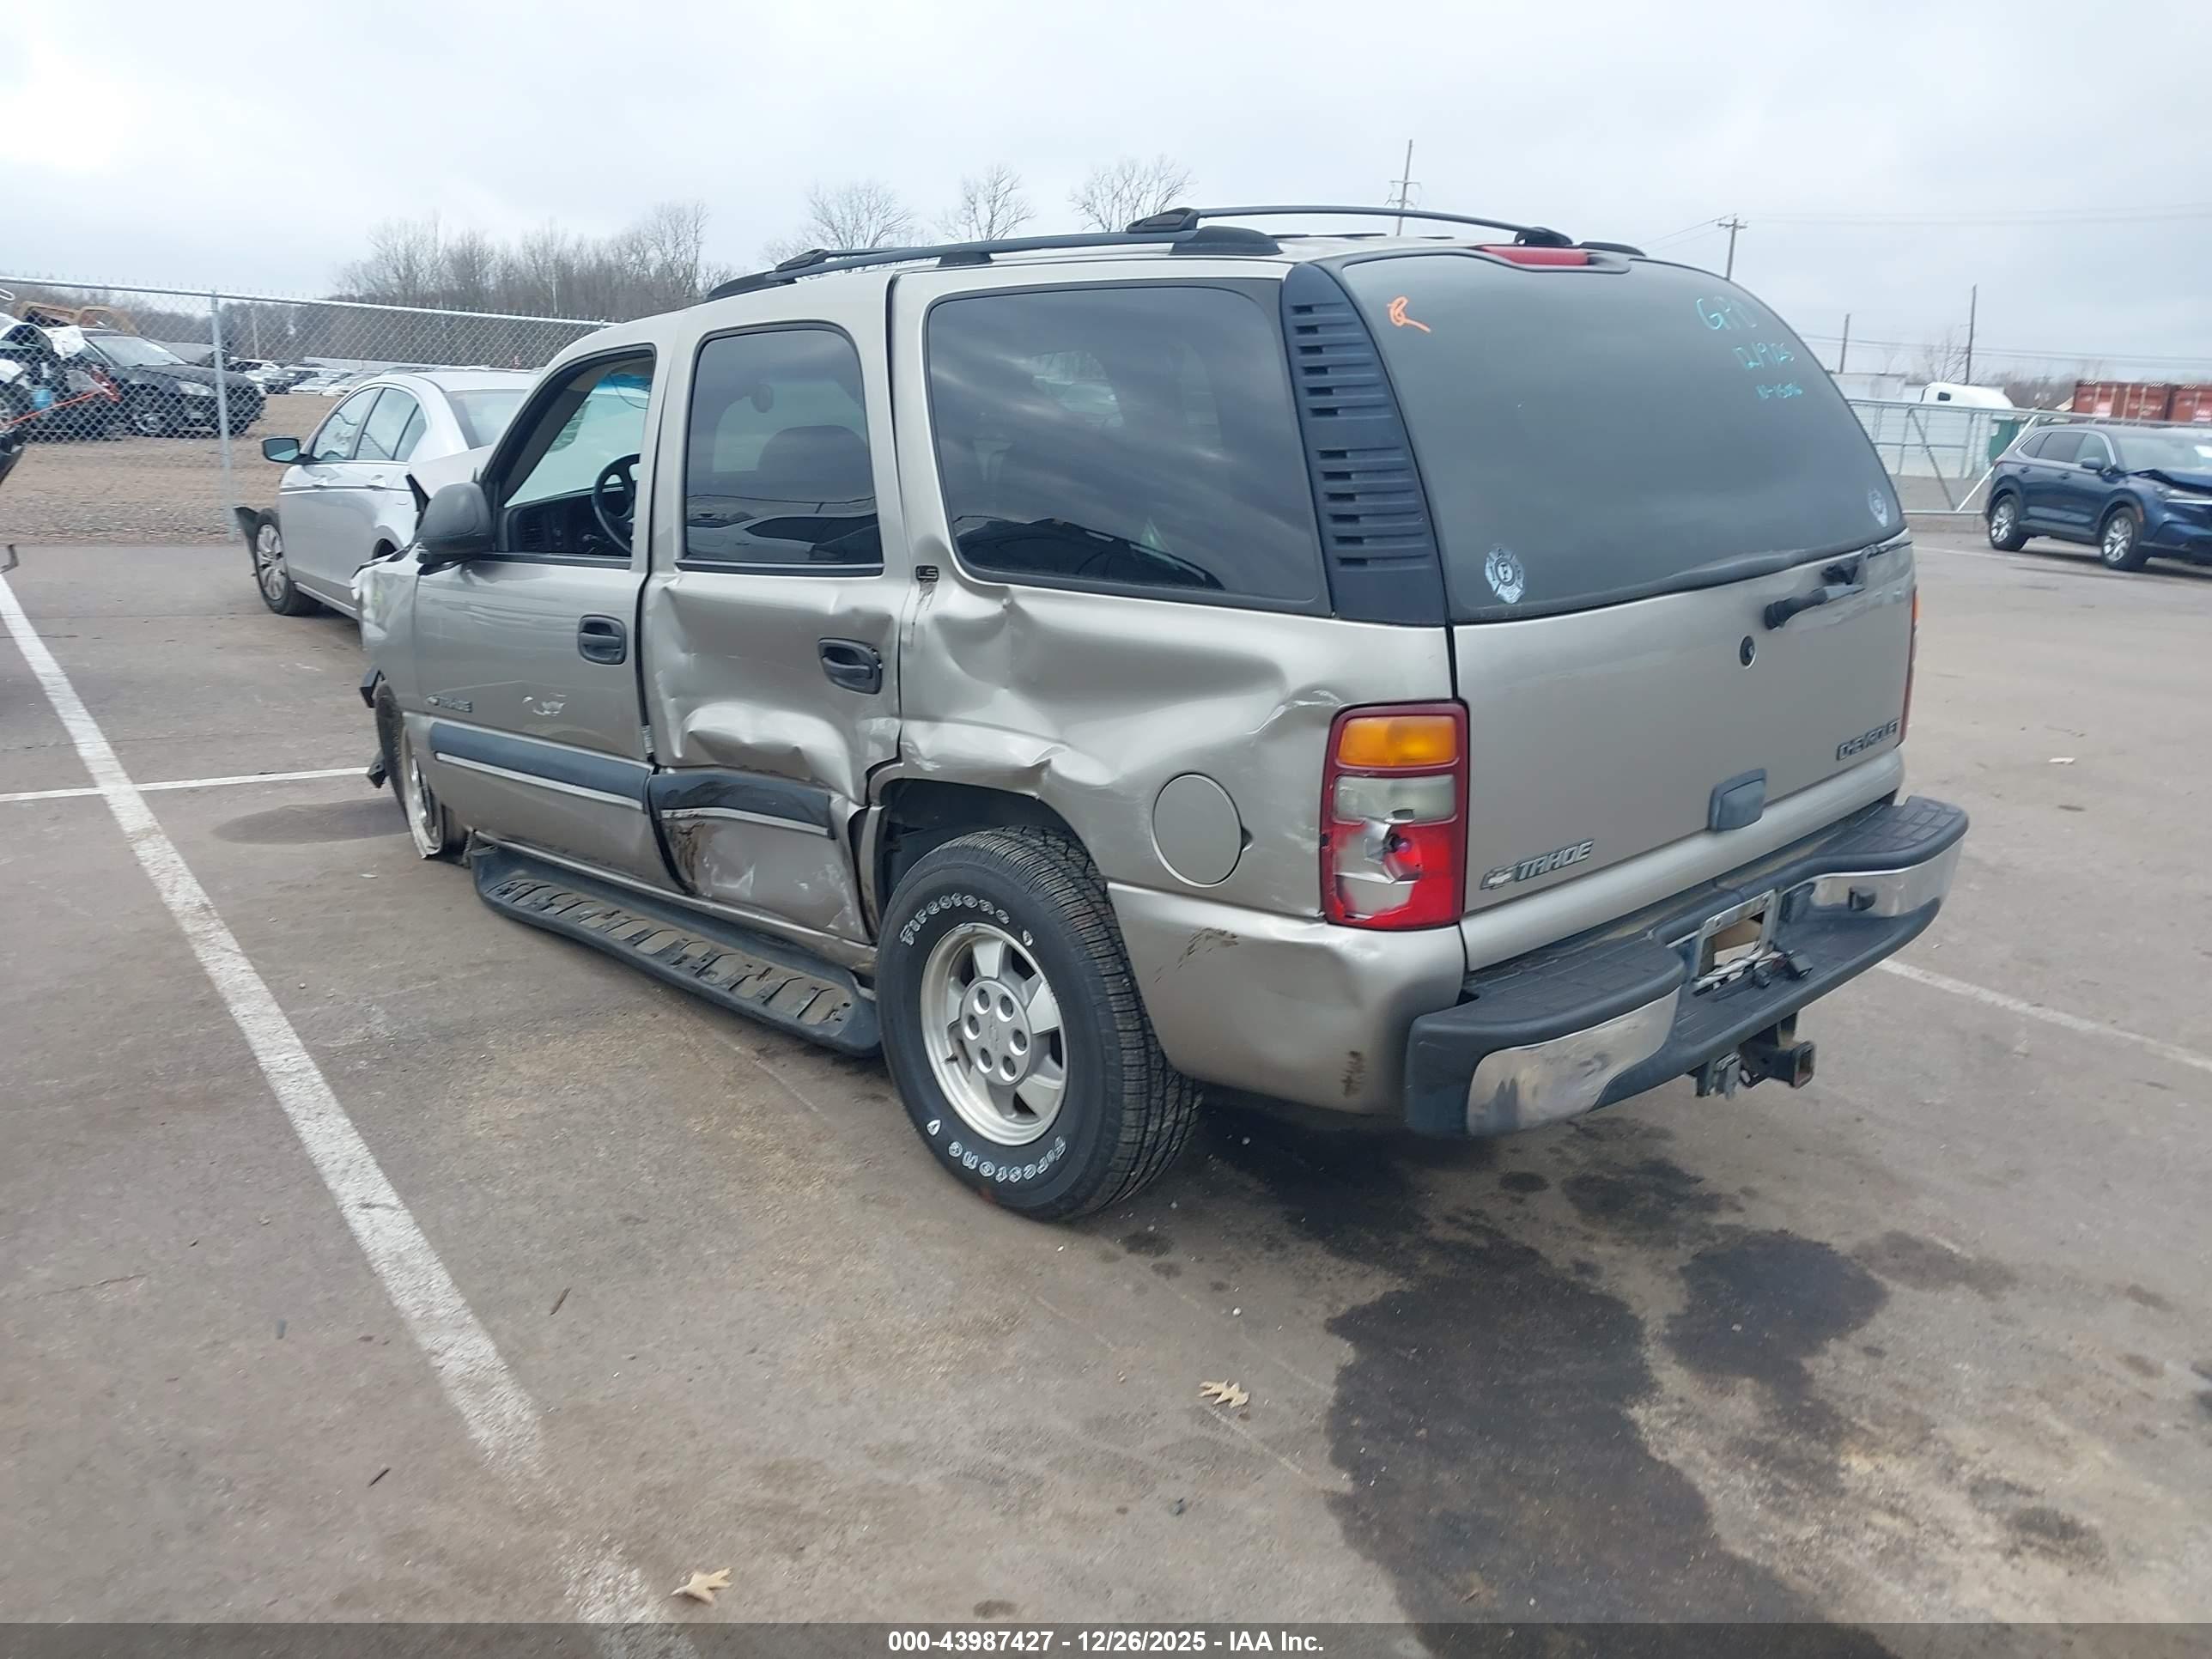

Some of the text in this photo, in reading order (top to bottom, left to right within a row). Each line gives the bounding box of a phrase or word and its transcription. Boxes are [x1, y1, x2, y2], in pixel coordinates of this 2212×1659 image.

[1514, 839, 1594, 881] TAHOE
[899, 892, 1010, 946] Firestone
[948, 1135, 1066, 1183] Firestone
